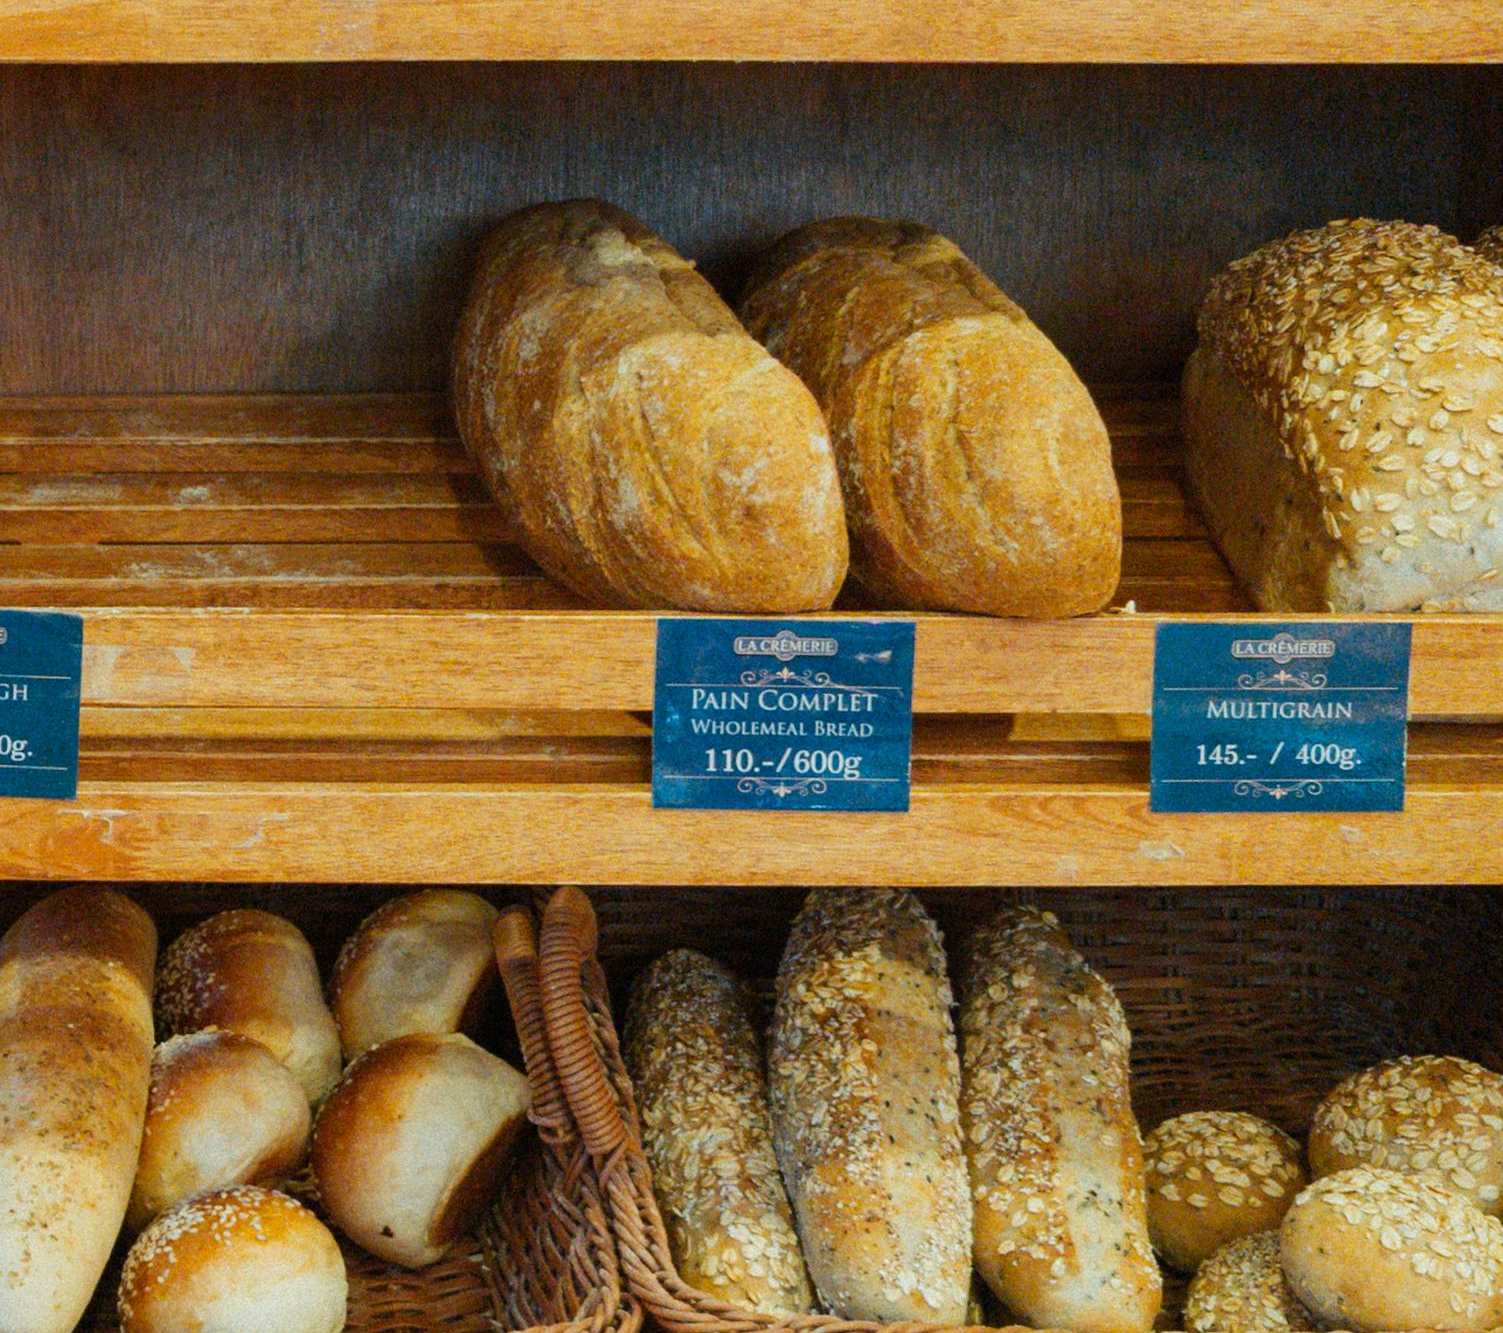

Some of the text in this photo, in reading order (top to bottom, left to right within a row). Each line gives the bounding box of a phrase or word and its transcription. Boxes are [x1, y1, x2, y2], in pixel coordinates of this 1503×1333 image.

[737, 640, 757, 652] LA
[1235, 642, 1255, 654] LA
[692, 688, 879, 712] PAIN COMPLET
[1206, 700, 1353, 719] MULTIGRAIN
[691, 719, 874, 738] WHOLEMEAL BREAD
[1197, 741, 1362, 771] 145.- / 400g.
